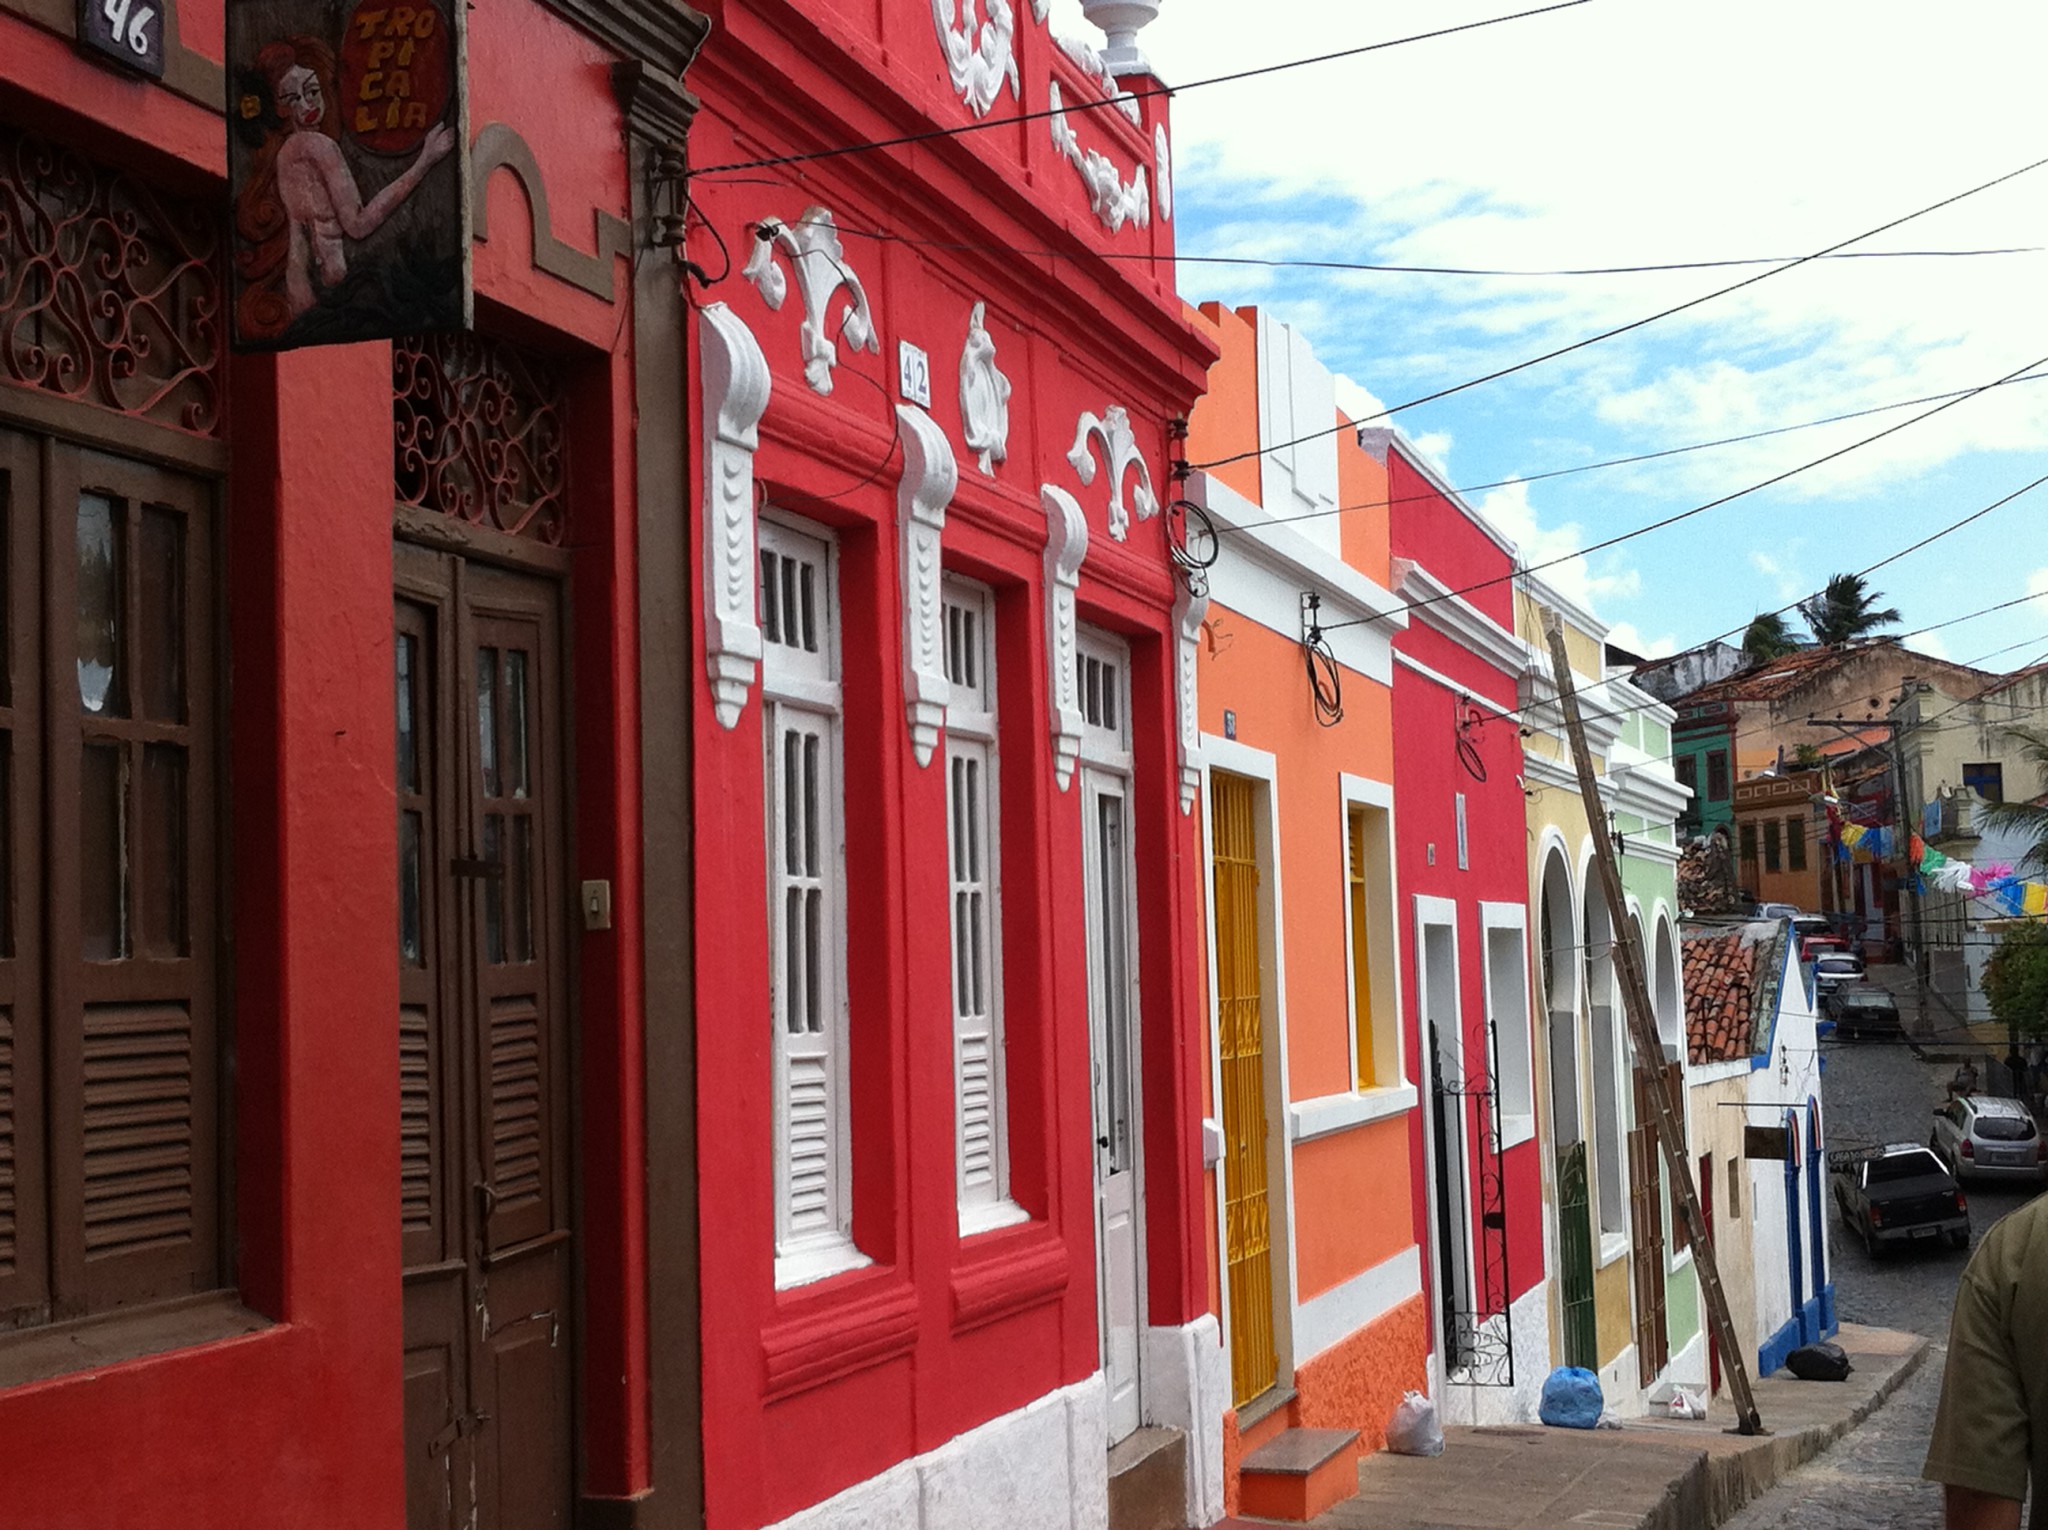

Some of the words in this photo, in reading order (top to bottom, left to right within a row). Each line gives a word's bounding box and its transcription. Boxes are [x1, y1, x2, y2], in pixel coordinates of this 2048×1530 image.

[104, 0, 155, 55] 46
[356, 6, 436, 38] TRO
[368, 37, 415, 68] PI
[359, 70, 410, 100] CA
[355, 97, 427, 132] LIA
[904, 356, 927, 394] 42
